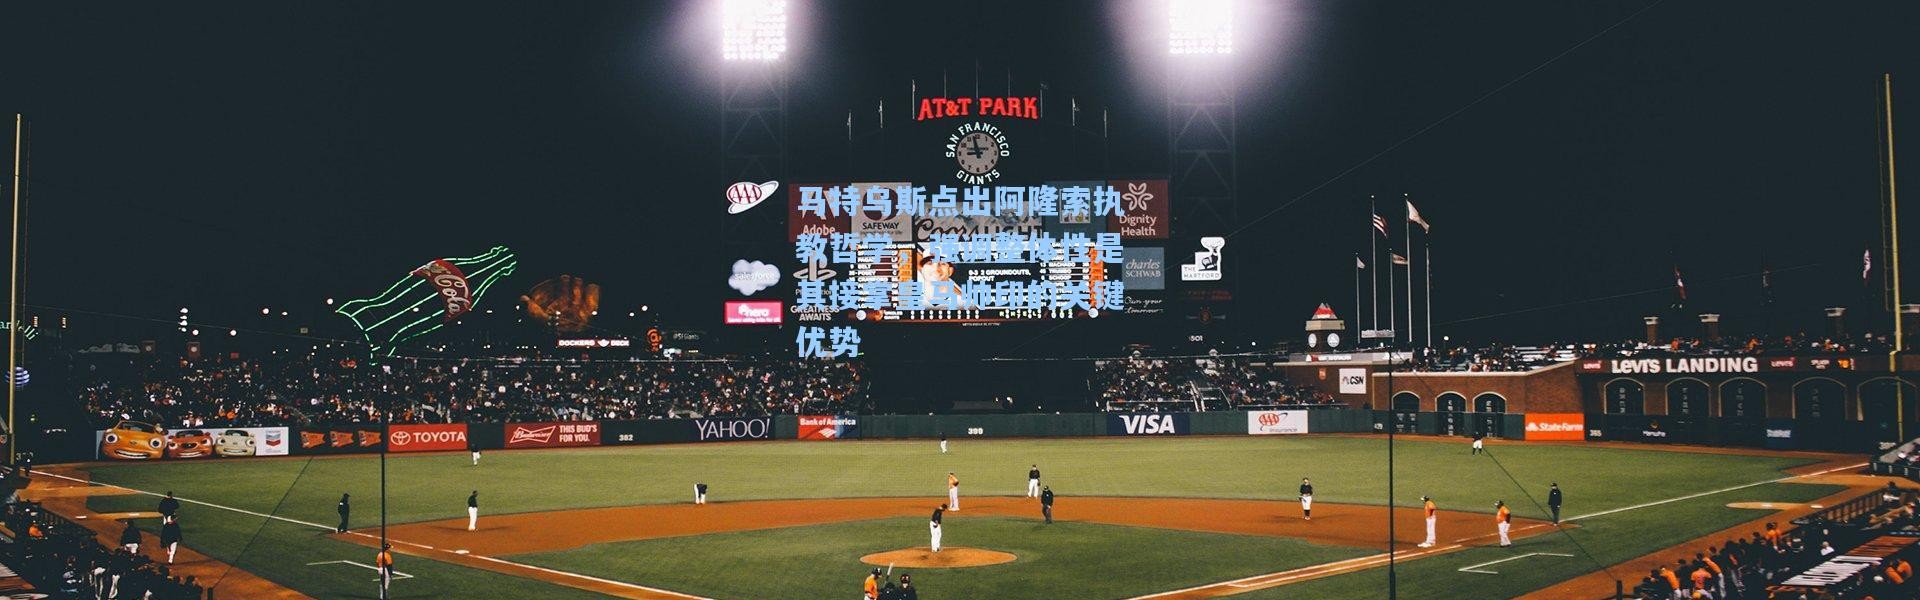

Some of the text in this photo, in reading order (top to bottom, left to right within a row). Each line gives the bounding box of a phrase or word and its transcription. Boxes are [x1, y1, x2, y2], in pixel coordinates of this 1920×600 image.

[918, 97, 1038, 120] AT&T PARK
[946, 121, 1010, 158] SAN FRANCISCO
[956, 169, 1001, 185] GIANTS
[731, 184, 760, 204] AAA
[863, 222, 899, 230] SAFEWAY
[1119, 215, 1157, 226] Dignity
[803, 224, 835, 236] Adobe
[1121, 226, 1156, 236] Health
[1125, 259, 1161, 269] charles
[734, 270, 777, 281] salesforce
[799, 313, 832, 321] AWAITS
[558, 339, 630, 347] DOCKERS DECK
[1665, 357, 1758, 373] LANDING
[800, 418, 857, 426] Bank of America
[1119, 415, 1176, 434] VISA
[1259, 413, 1279, 426] AAA
[559, 424, 598, 433] THIS BUD'S
[695, 418, 771, 441] YAHOO!
[413, 431, 467, 442] TOYOTA
[559, 434, 573, 442] FOR
